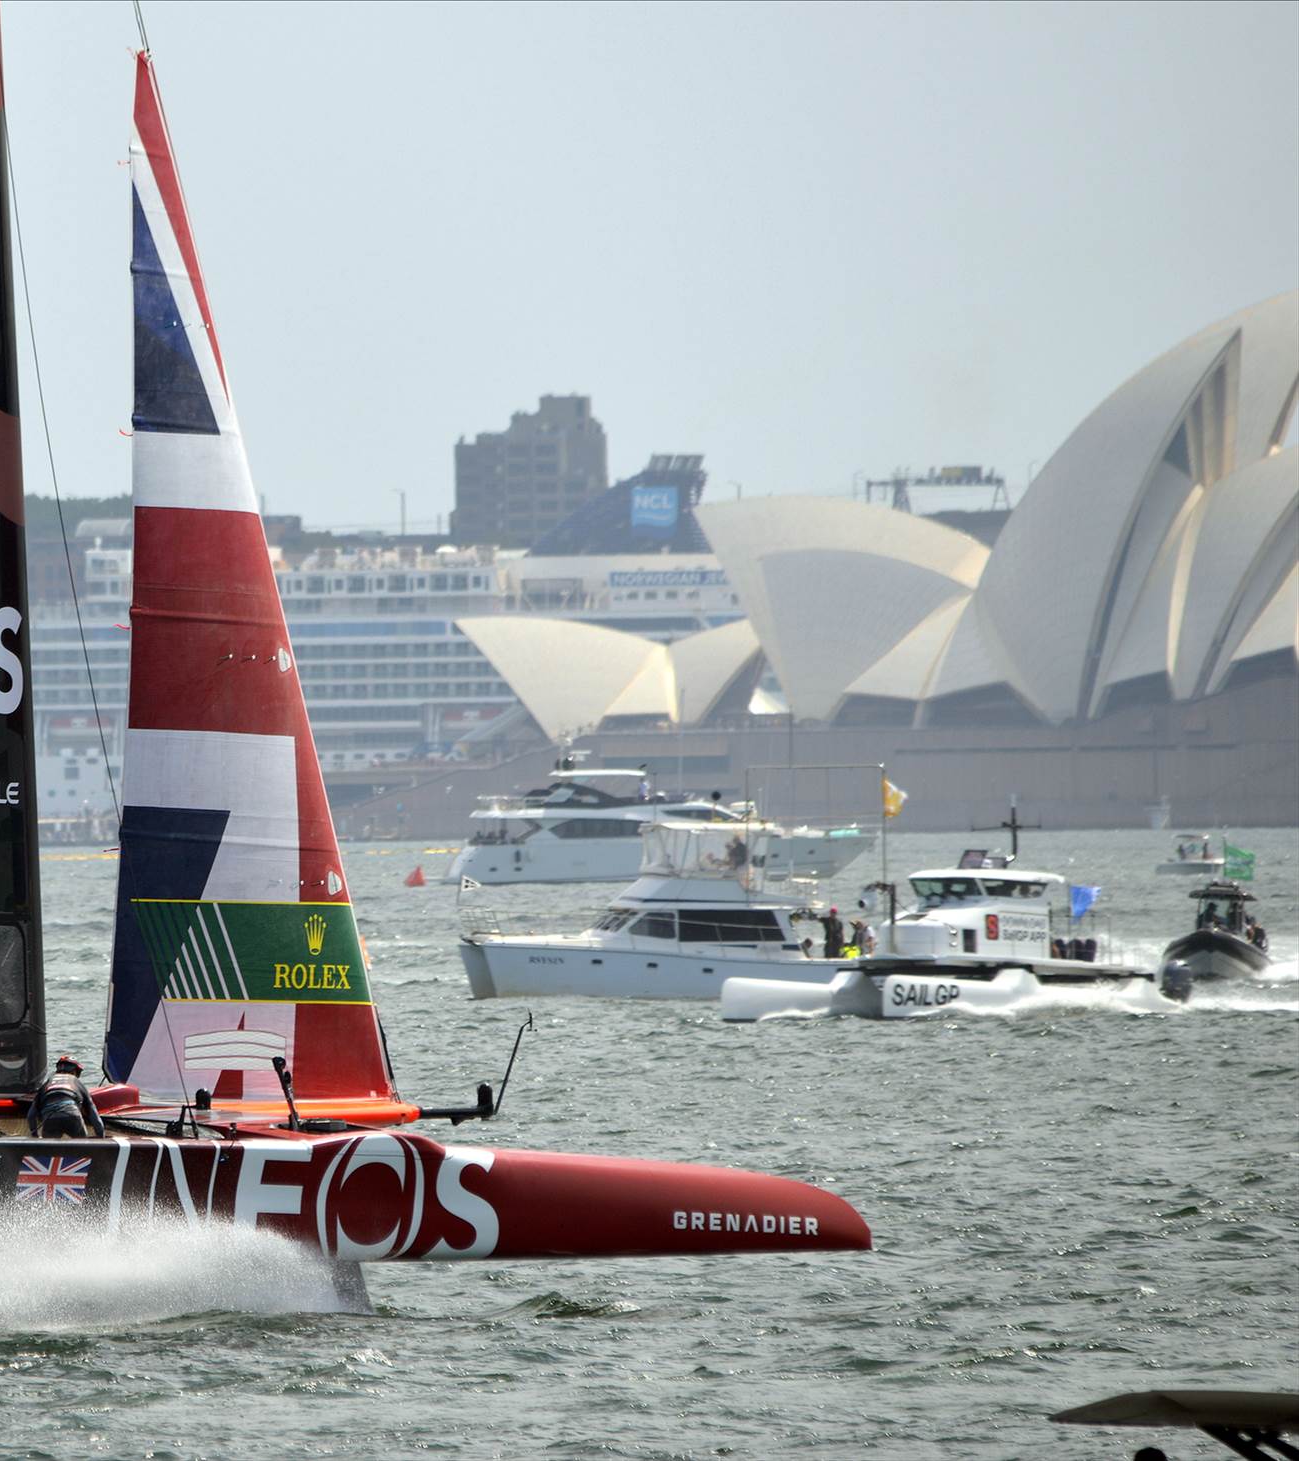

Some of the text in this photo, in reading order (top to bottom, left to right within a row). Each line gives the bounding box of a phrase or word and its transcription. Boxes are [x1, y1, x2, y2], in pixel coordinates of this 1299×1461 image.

[634, 494, 670, 509] NCL
[613, 573, 700, 585] NORWEGIAN
[273, 963, 351, 989] ROLEX
[106, 1134, 500, 1261] INEOS
[673, 1211, 819, 1236] GRENADIER
